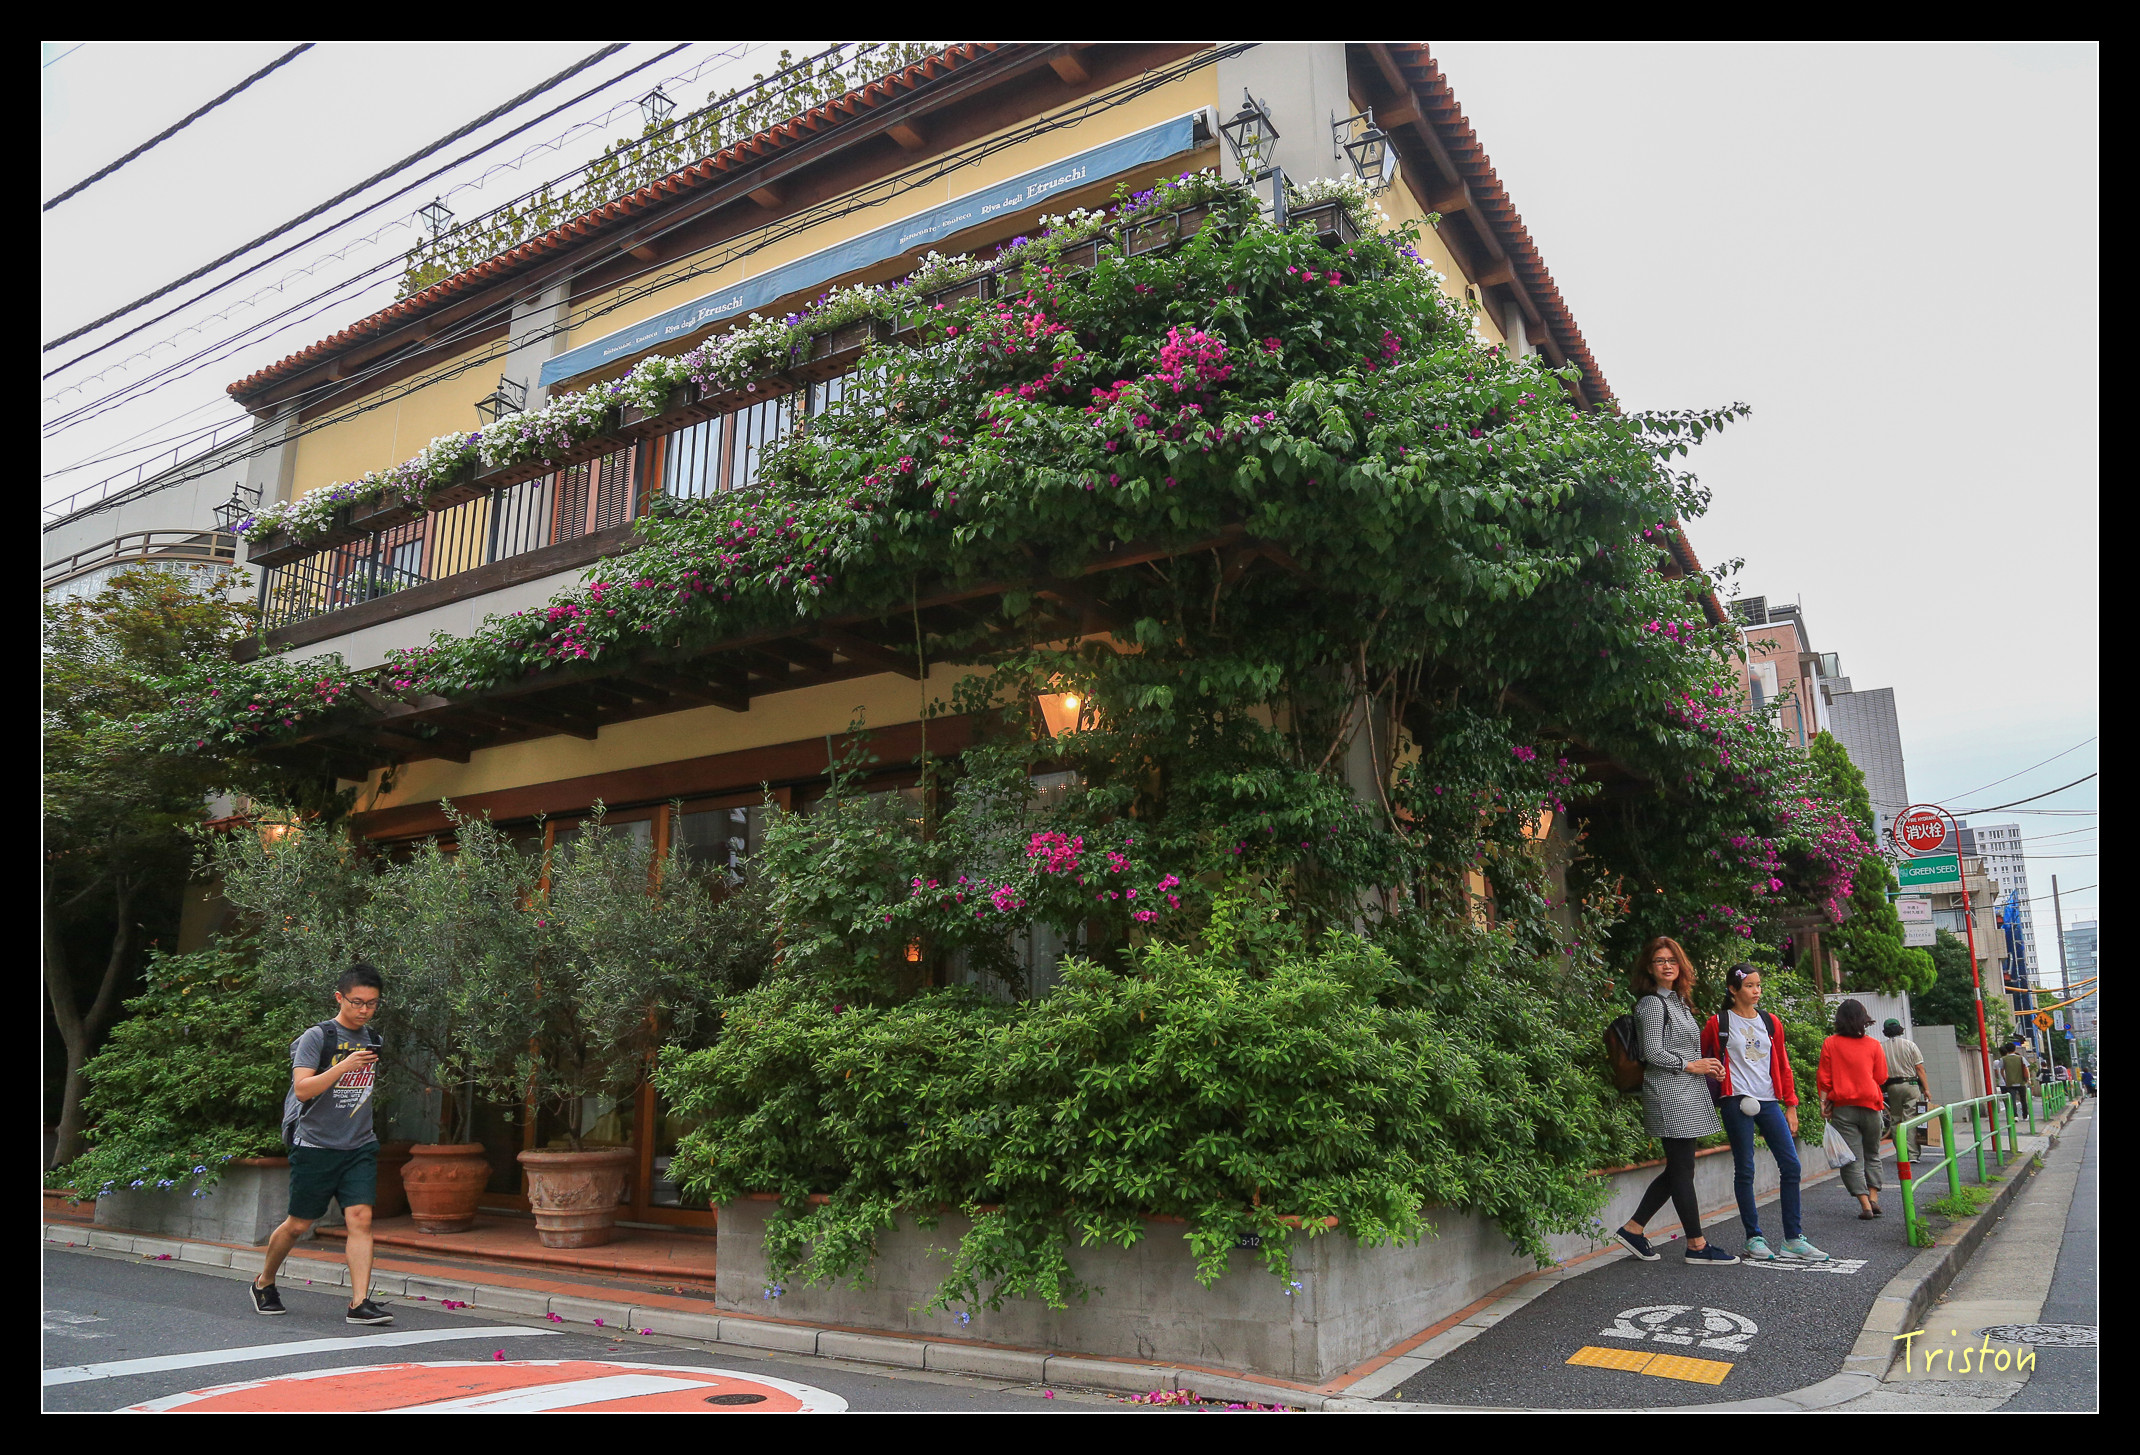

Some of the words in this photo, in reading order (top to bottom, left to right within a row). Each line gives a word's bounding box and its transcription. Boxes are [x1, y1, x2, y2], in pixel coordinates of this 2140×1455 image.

[981, 203, 1001, 215] Riva
[1003, 194, 1023, 208] degli
[1026, 166, 1086, 200] Etruschi
[664, 325, 680, 334] Riva
[681, 317, 696, 328] degli
[697, 296, 743, 321] Etruschi
[1906, 822, 1943, 840] 消火栓
[1908, 867, 1935, 876] GREEN
[1936, 864, 1957, 875] SEED
[339, 1073, 375, 1087] HEART
